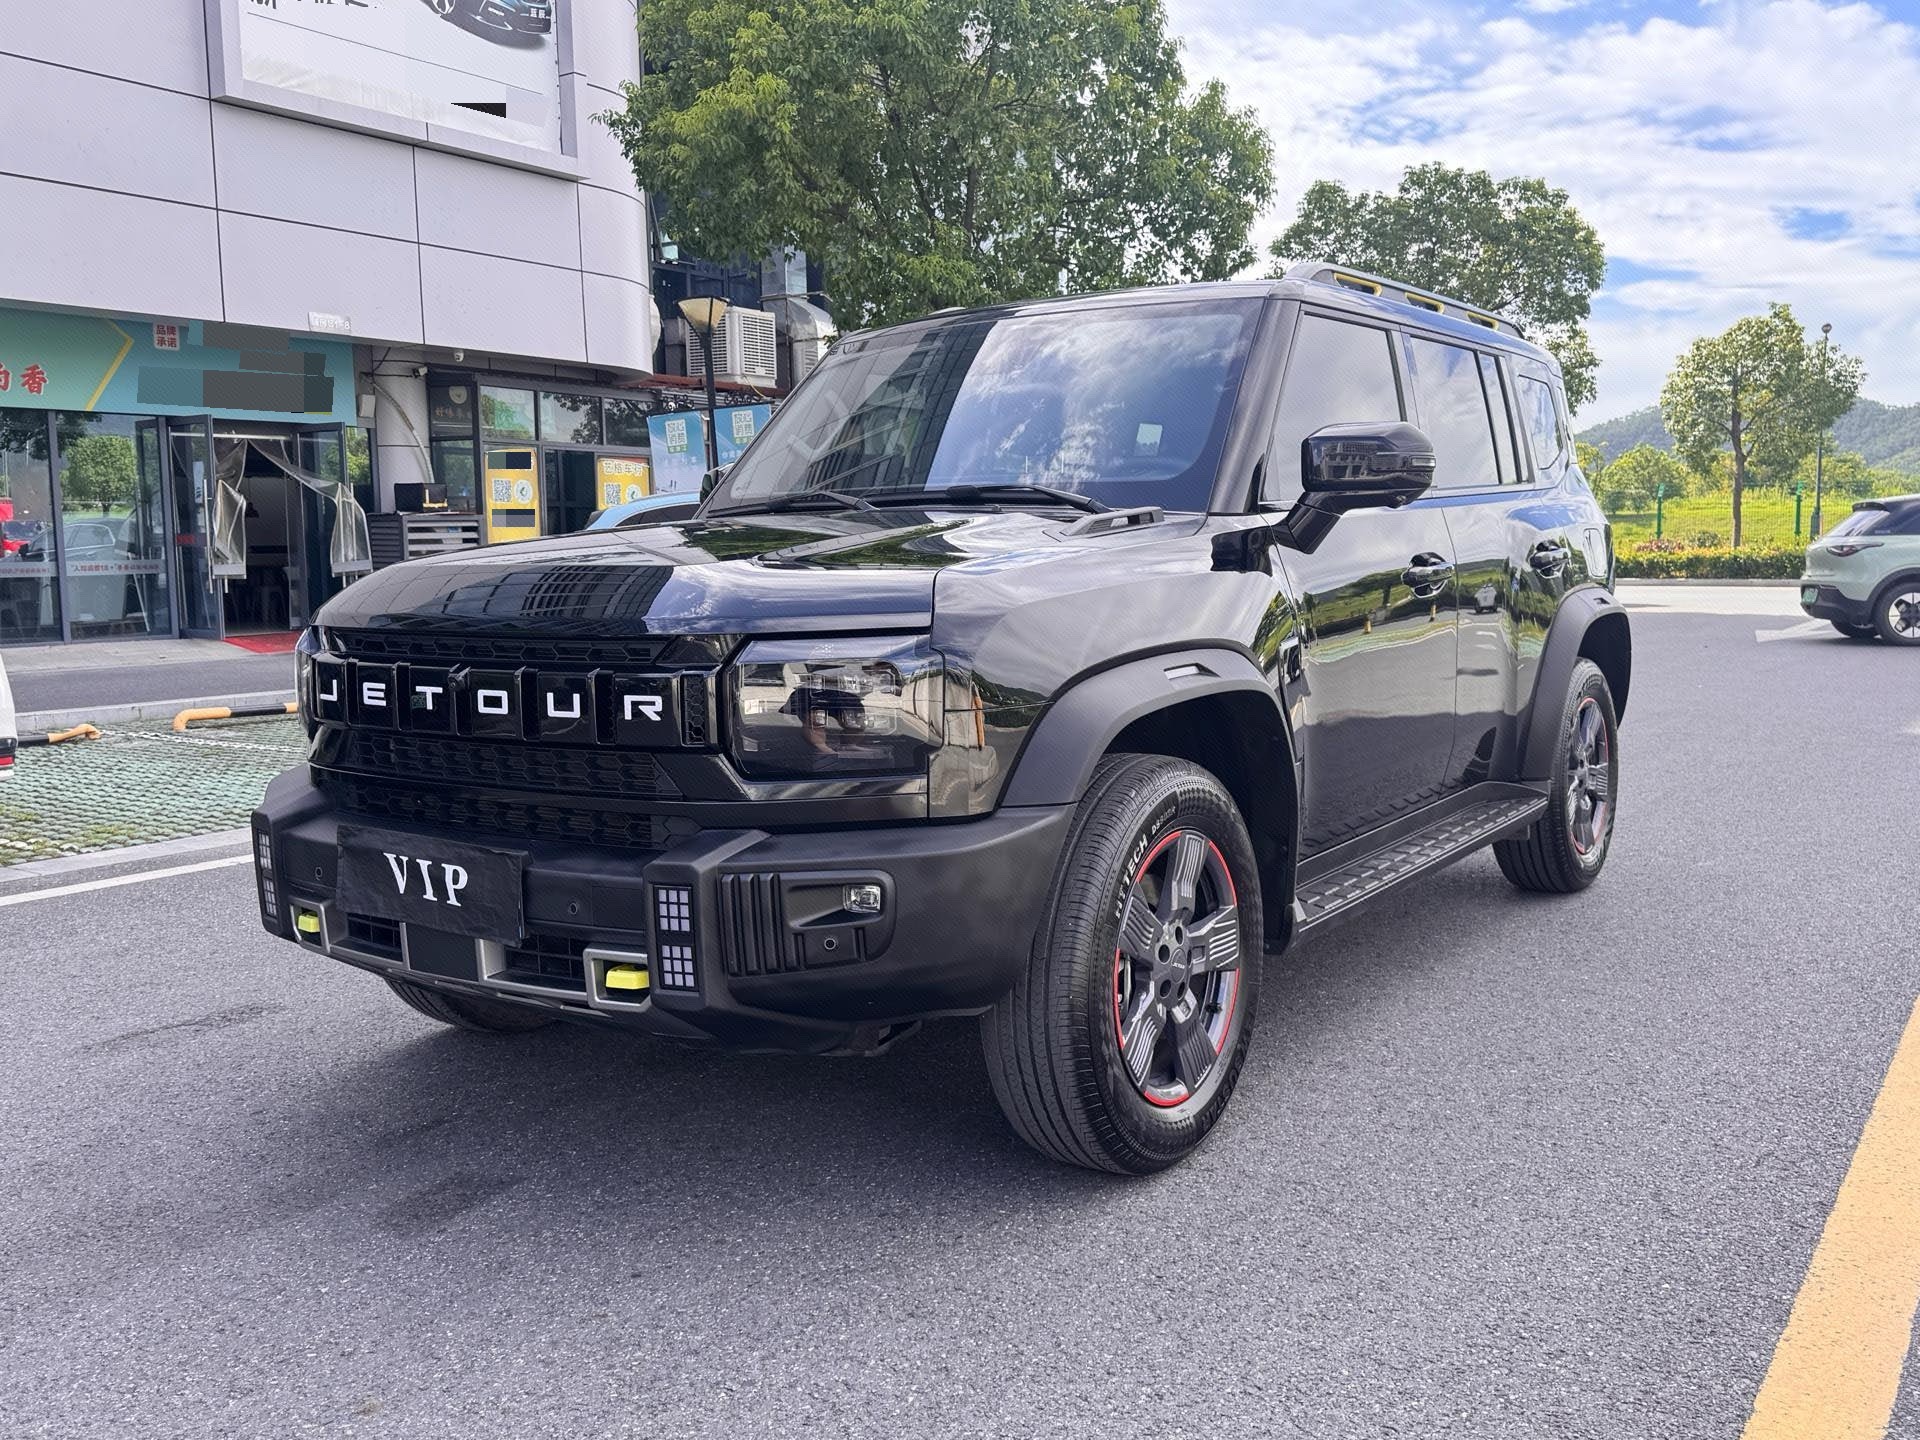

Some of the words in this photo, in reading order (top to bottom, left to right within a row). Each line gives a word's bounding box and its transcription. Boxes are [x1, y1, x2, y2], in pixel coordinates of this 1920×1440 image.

[157, 324, 177, 336] 品牌
[157, 336, 177, 348] 承诺
[319, 679, 663, 721] JETOUR
[383, 852, 469, 907] VIP
